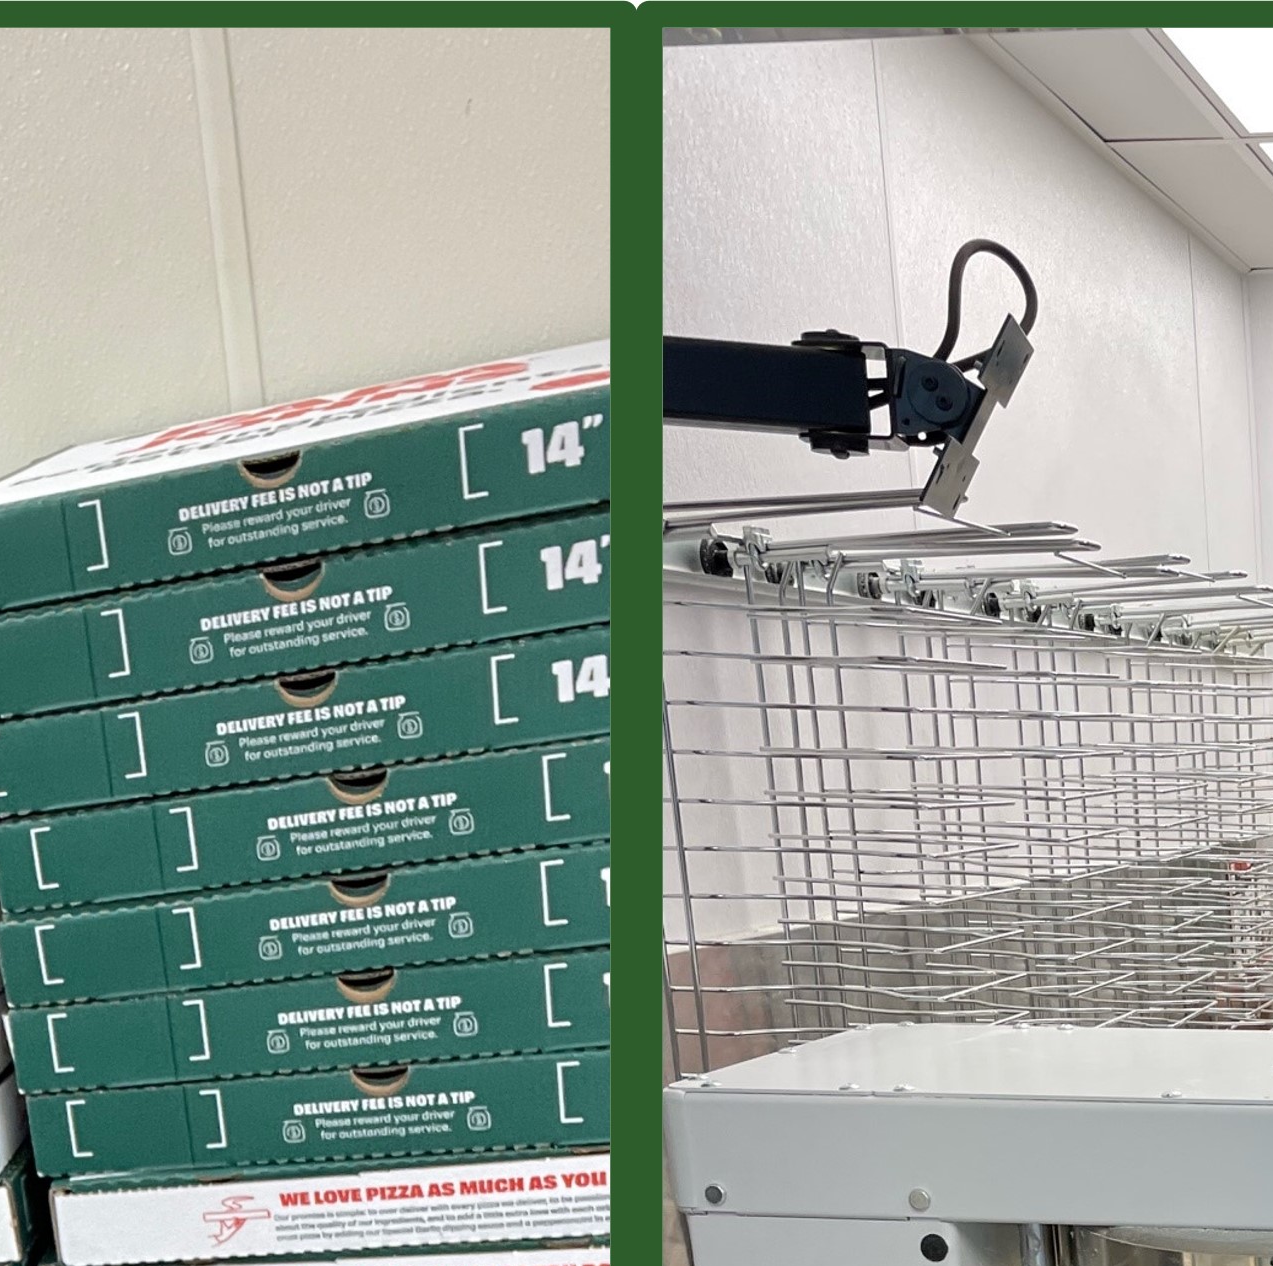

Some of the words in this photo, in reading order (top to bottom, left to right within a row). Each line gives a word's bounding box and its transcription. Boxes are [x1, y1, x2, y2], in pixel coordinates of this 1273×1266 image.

[522, 414, 603, 474] 14"
[178, 496, 248, 522] DELIVERY
[251, 490, 277, 508] FEE
[278, 486, 296, 502] IS
[297, 479, 329, 498] NOT
[332, 477, 344, 492] A
[345, 472, 372, 489] TIP
[201, 519, 241, 534] Please
[242, 508, 284, 526] reward
[285, 505, 313, 520] your
[315, 497, 351, 513] driver
[207, 536, 225, 548] for
[227, 523, 299, 545] outstanding
[301, 514, 348, 531] service.
[200, 607, 270, 631] DELIVERY
[272, 602, 298, 619] FEE
[300, 599, 317, 614] IS
[318, 592, 350, 611] NOT
[353, 590, 365, 605] A
[366, 585, 392, 602] TIP
[223, 629, 262, 644] Please
[263, 620, 304, 637] reward
[306, 617, 334, 632] your
[336, 610, 371, 625] driver
[229, 646, 246, 657] for
[248, 634, 320, 654] outstanding
[321, 627, 368, 642] service.
[279, 1191, 310, 1207] WE
[313, 1188, 362, 1205] LOVE
[365, 1183, 424, 1201] PIZZA
[427, 1182, 455, 1197] AS
[458, 1176, 525, 1195] MUCH
[528, 1174, 557, 1191] AS
[561, 1171, 607, 1188] YOU
